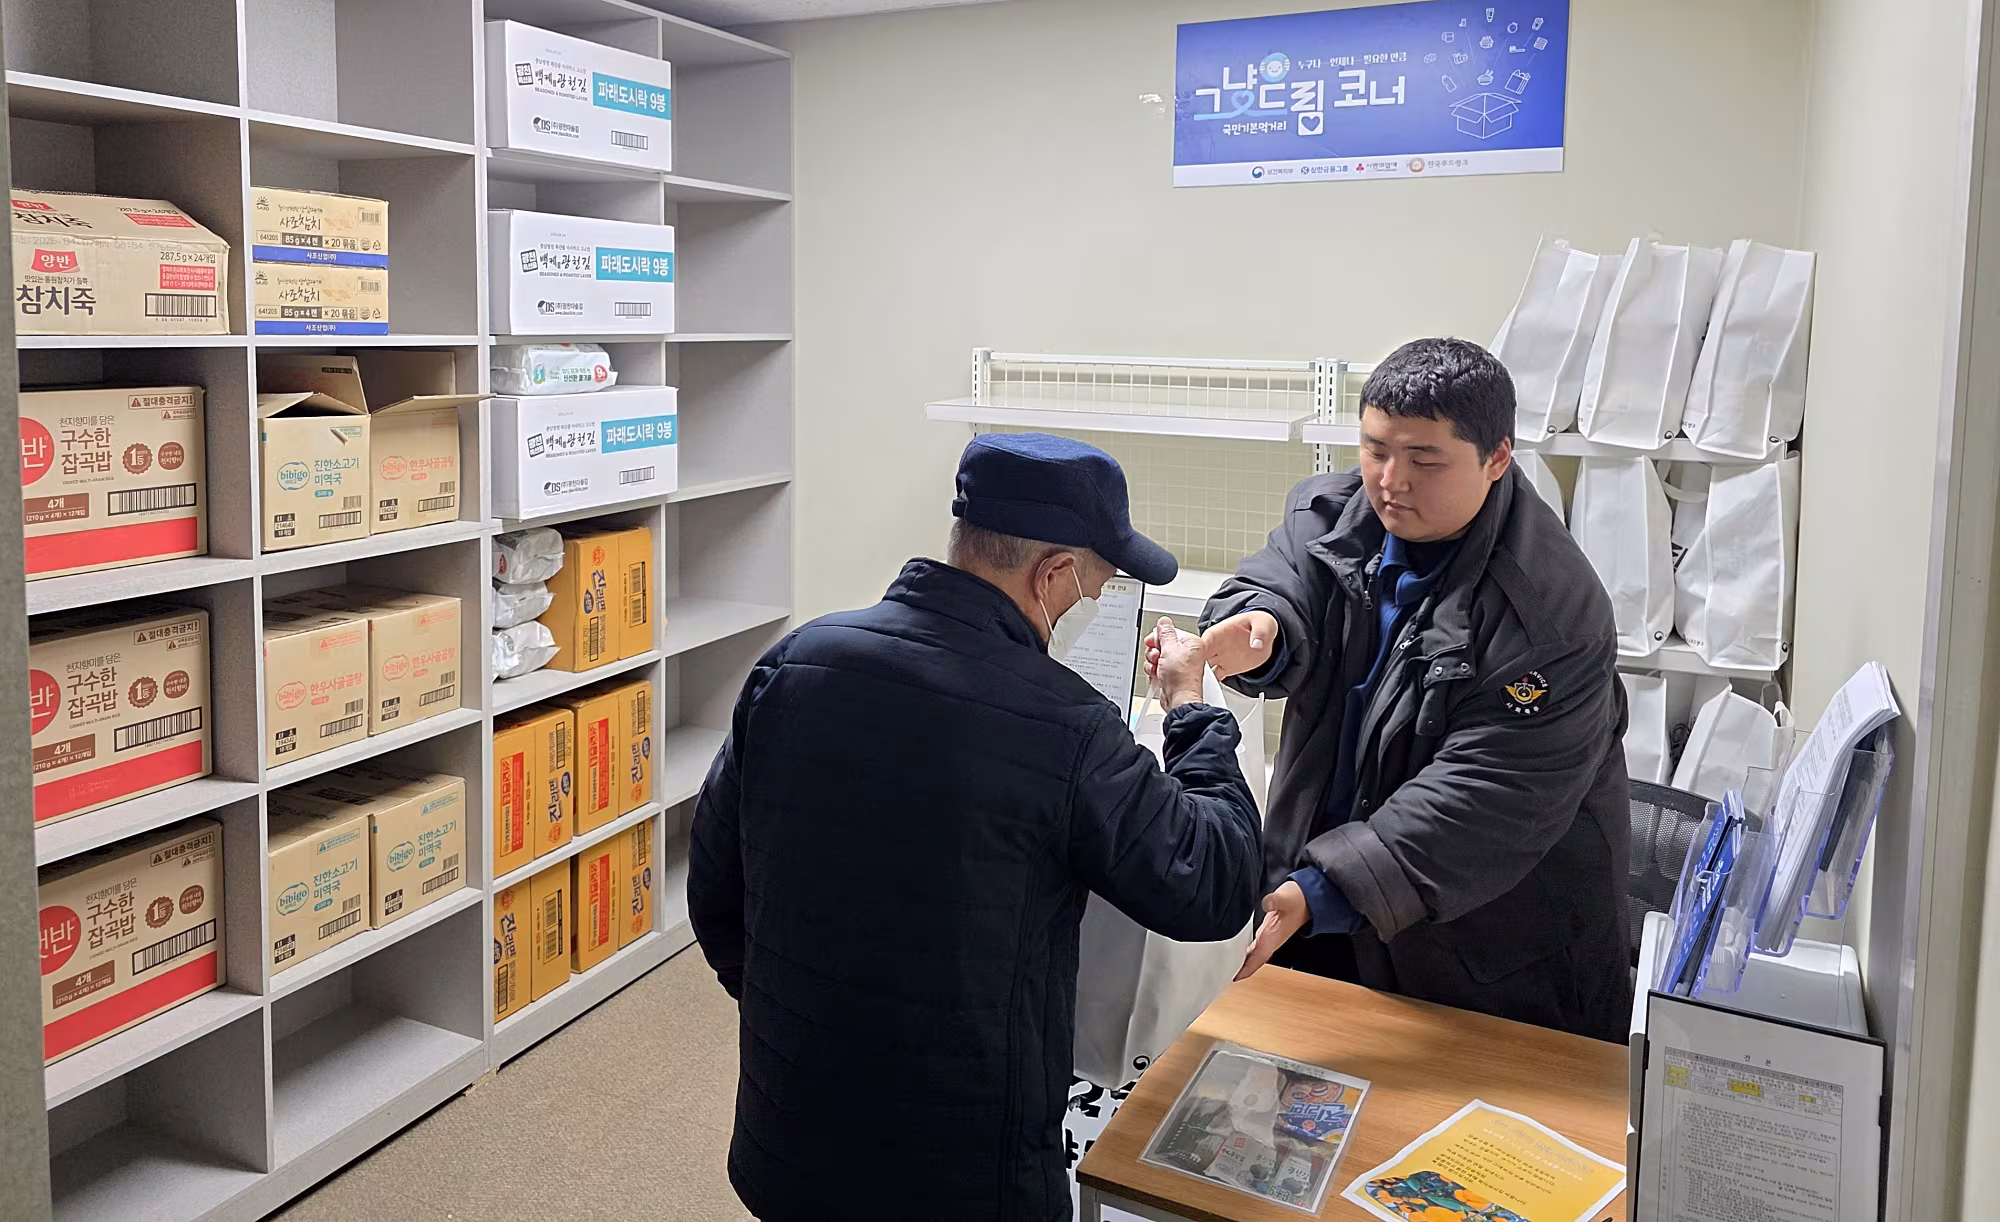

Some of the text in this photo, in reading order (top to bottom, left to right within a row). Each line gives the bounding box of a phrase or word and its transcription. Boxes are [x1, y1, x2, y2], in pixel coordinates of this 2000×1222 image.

[1298, 52, 1407, 69] 누구나 언제나 필요한 만큼
[598, 81, 666, 113] 파래도시락 9봉
[1333, 69, 1406, 108] 코너
[1222, 120, 1287, 136] 국민기본먹거리
[1310, 165, 1348, 174] 신한금융그룹
[1427, 159, 1469, 169] 전국푸드뱅크
[279, 214, 321, 231] 사조참치
[342, 238, 356, 250] 묶음
[40, 253, 71, 269] 양반
[306, 252, 337, 261] 사조산업(주)
[600, 254, 669, 277] 파래도시락 9봉
[24, 275, 88, 285] 맛있는 동원참치가 듬뿍
[15, 284, 97, 316] 참치죽
[278, 286, 320, 303] 사조참치
[341, 309, 356, 320] 묶음
[305, 324, 336, 332] 사조산업(주)
[142, 394, 193, 407] 절대충격금지!
[58, 414, 116, 428] 천지향미를 담은
[60, 427, 112, 451] 구수한
[606, 420, 673, 446] 파래도시락 9봉
[61, 450, 113, 475] 잡곡밥
[313, 457, 360, 472] 진한소고기
[382, 461, 407, 474] bibigo
[409, 456, 455, 471] 한우사골곰탕
[280, 468, 309, 482] bibigo
[314, 472, 343, 486] 미역국
[47, 497, 65, 510] 4개
[591, 569, 607, 613] 진라면
[148, 621, 199, 640] 절대충격금지!
[65, 652, 121, 674] 천지향미를 담은
[384, 661, 408, 673] bibigo
[66, 665, 118, 696] 구수한
[309, 672, 363, 696] 한우사골곰탕
[278, 687, 305, 701] bibigo
[67, 688, 119, 720] 잡곡밥
[54, 741, 72, 756] 4개
[631, 742, 644, 785] 진라면
[548, 777, 563, 824] 진라면
[417, 820, 457, 846] 진한소고기
[163, 834, 213, 860] 절대충격금지!
[389, 848, 414, 863] bibigo
[418, 839, 443, 857] 미역국
[312, 857, 359, 887] 진한소고기
[85, 877, 139, 905] 천지향미를 담은
[279, 888, 308, 907] bibigo
[313, 880, 341, 900] 미역국
[631, 873, 644, 915] 진라면
[86, 890, 135, 926] 구수한
[87, 913, 137, 950] 잡곡밥
[500, 912, 517, 960] 진라면
[75, 971, 92, 987] 4개
